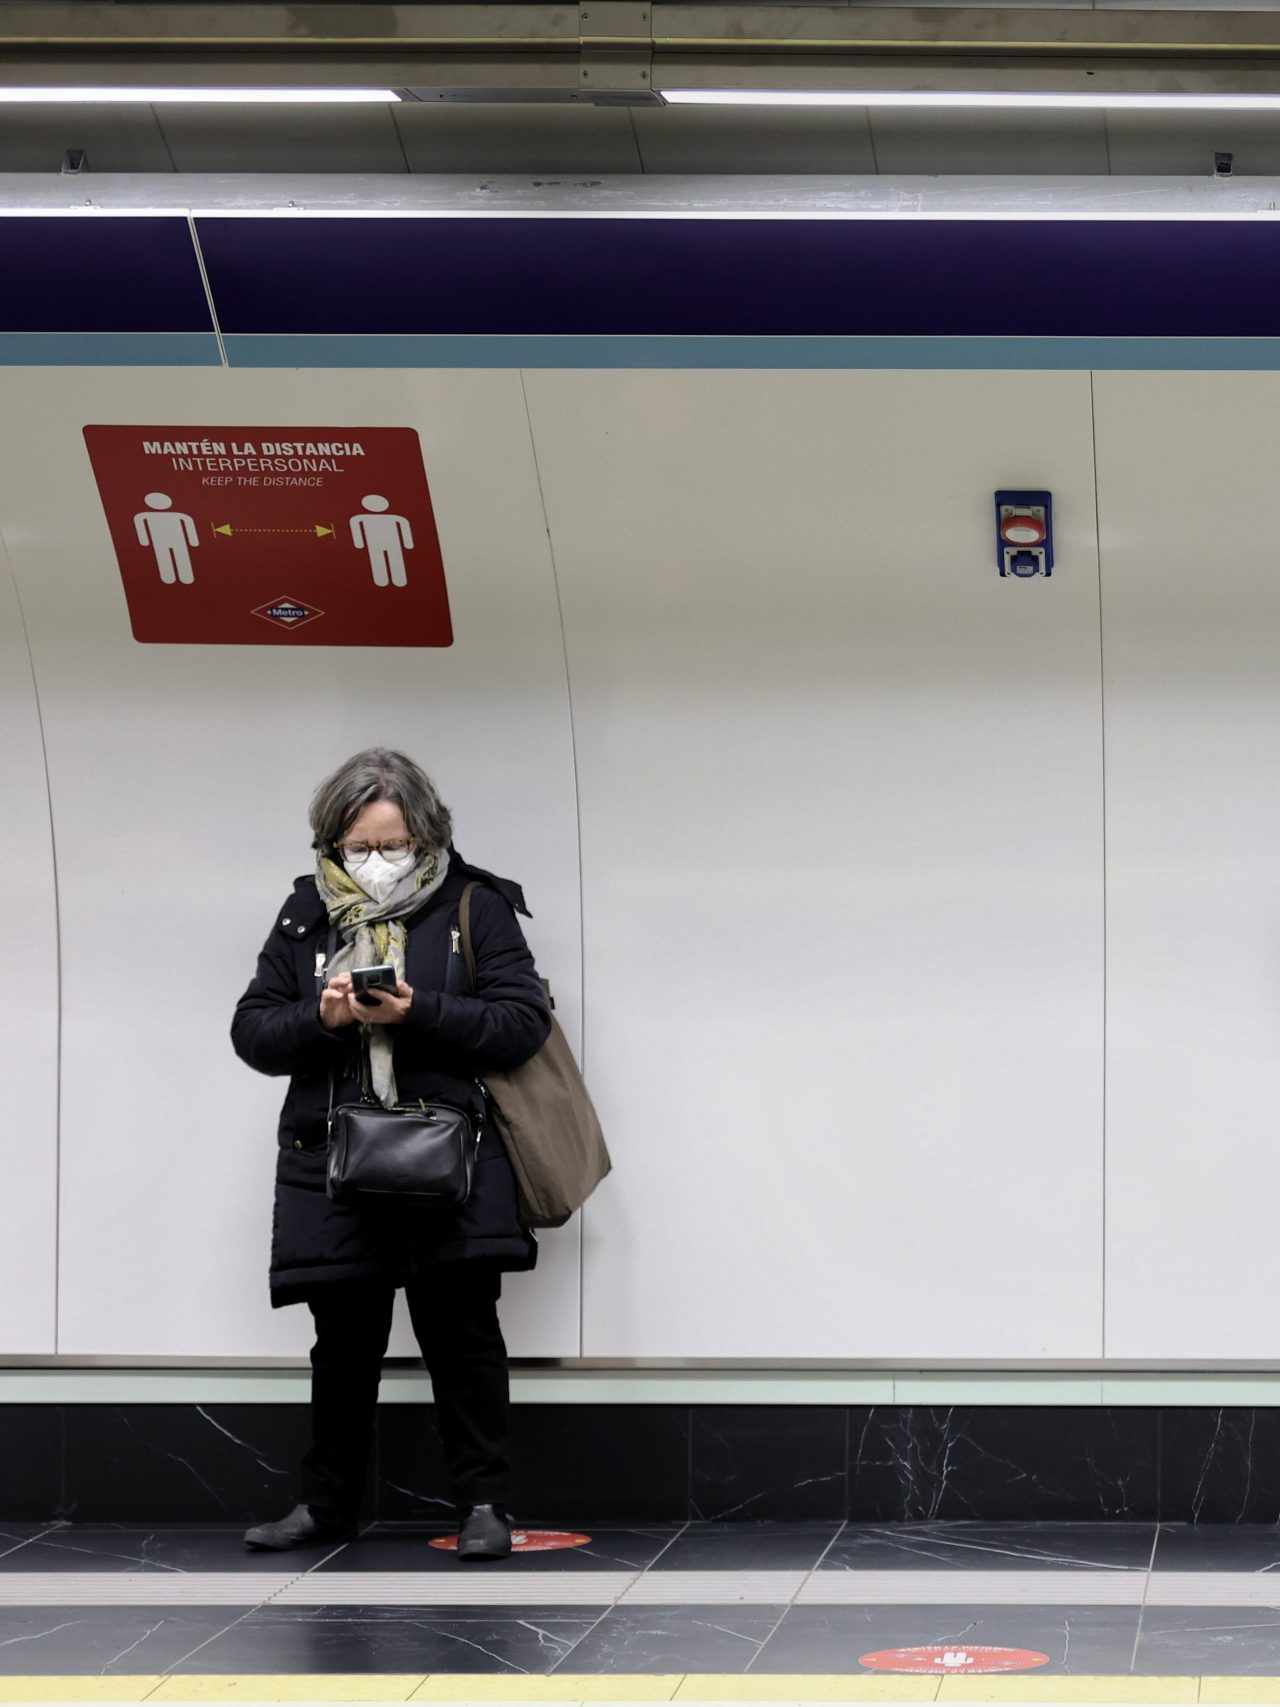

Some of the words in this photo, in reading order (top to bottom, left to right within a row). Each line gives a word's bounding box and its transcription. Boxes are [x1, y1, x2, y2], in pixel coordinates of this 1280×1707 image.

[142, 438, 227, 455] MANTÉN
[231, 442, 257, 456] LA
[261, 442, 365, 456] DISTANCIA
[172, 457, 345, 472] INTERPERSONAL
[202, 476, 233, 486] KEEP
[236, 476, 259, 486] THE
[263, 476, 324, 487] DISTANCE
[272, 608, 303, 616] Metro
